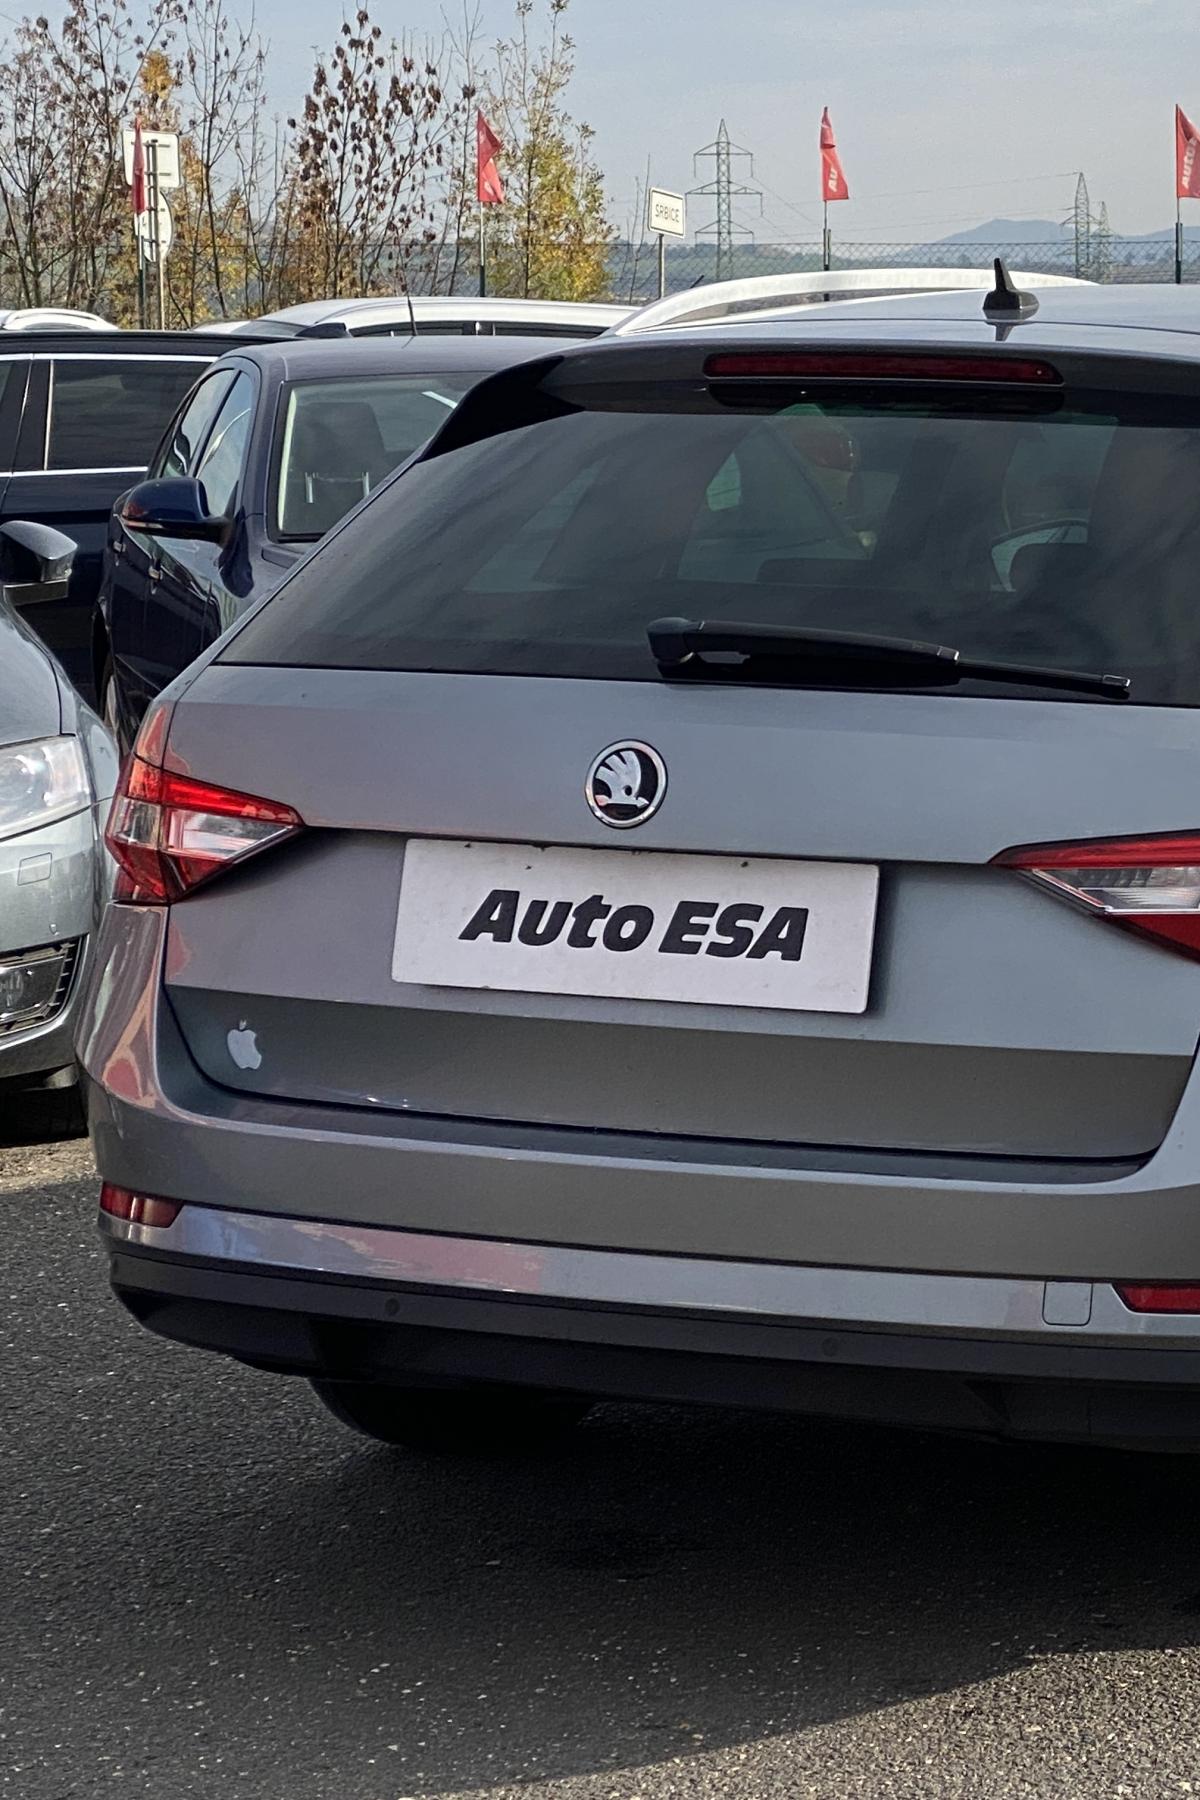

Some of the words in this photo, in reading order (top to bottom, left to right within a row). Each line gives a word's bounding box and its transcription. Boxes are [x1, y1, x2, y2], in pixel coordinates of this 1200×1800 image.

[1181, 145, 1196, 189] Auto
[655, 203, 681, 224] SRBICE
[458, 889, 654, 952] Auto
[658, 900, 809, 962] ESA
